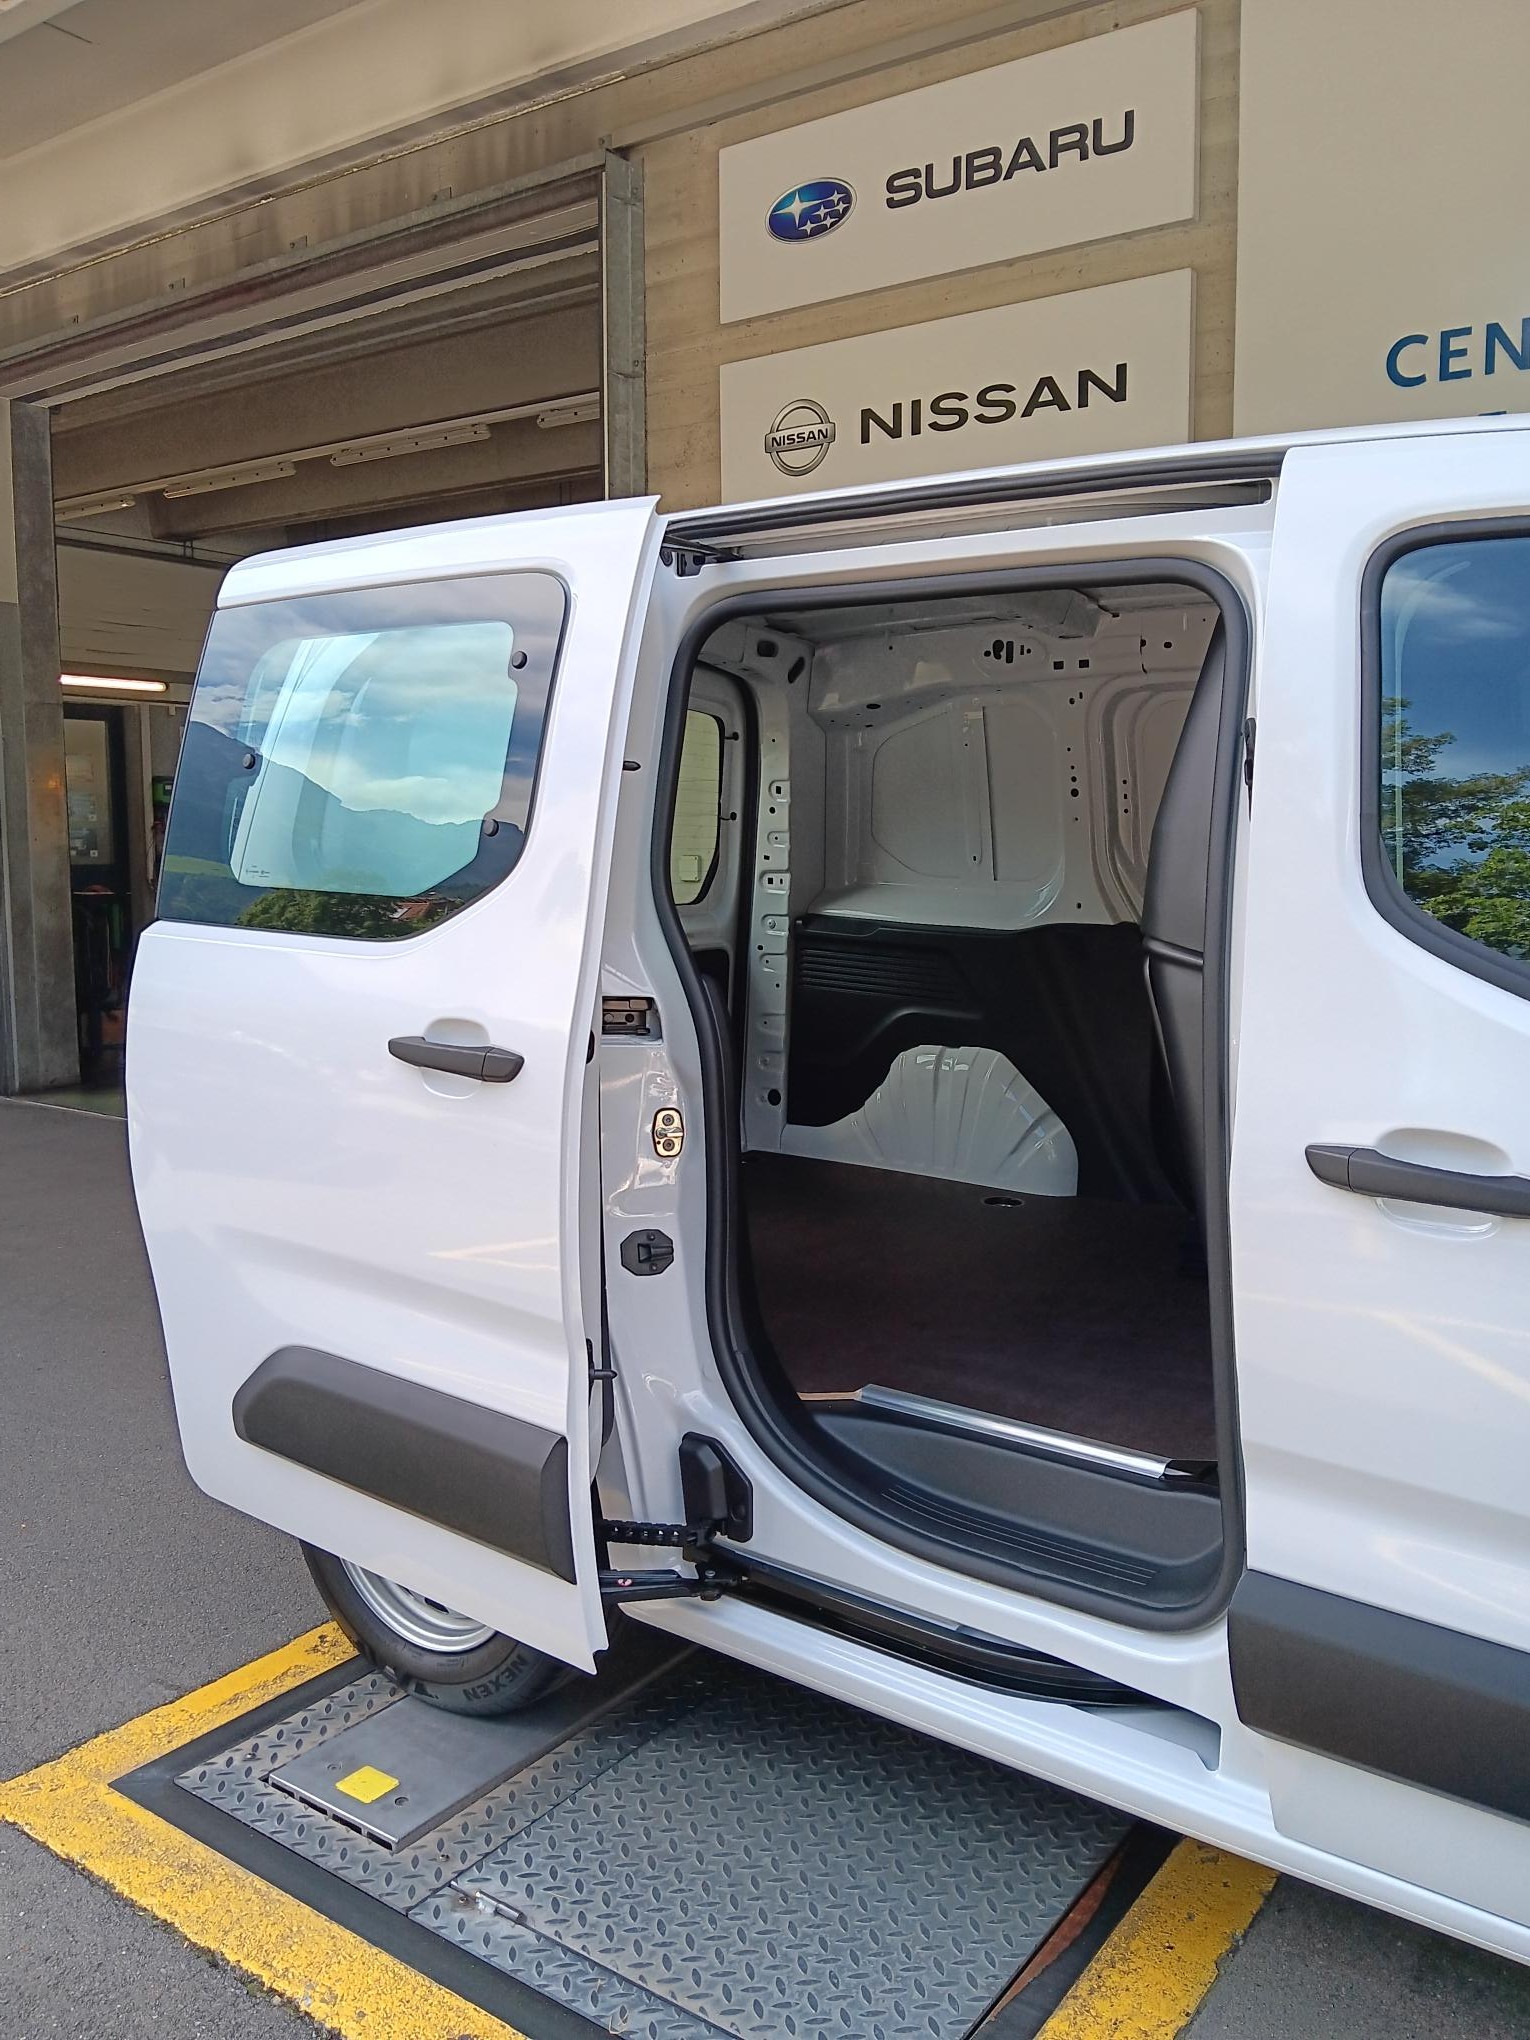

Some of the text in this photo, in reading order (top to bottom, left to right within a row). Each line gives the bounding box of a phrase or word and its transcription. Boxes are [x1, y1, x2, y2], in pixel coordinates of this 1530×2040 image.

[886, 109, 1135, 209] SUBARU
[1385, 316, 1530, 388] CEN
[771, 427, 829, 448] NISSAN
[860, 362, 1128, 444] NISSAN
[462, 1653, 528, 1701] NEXEN
